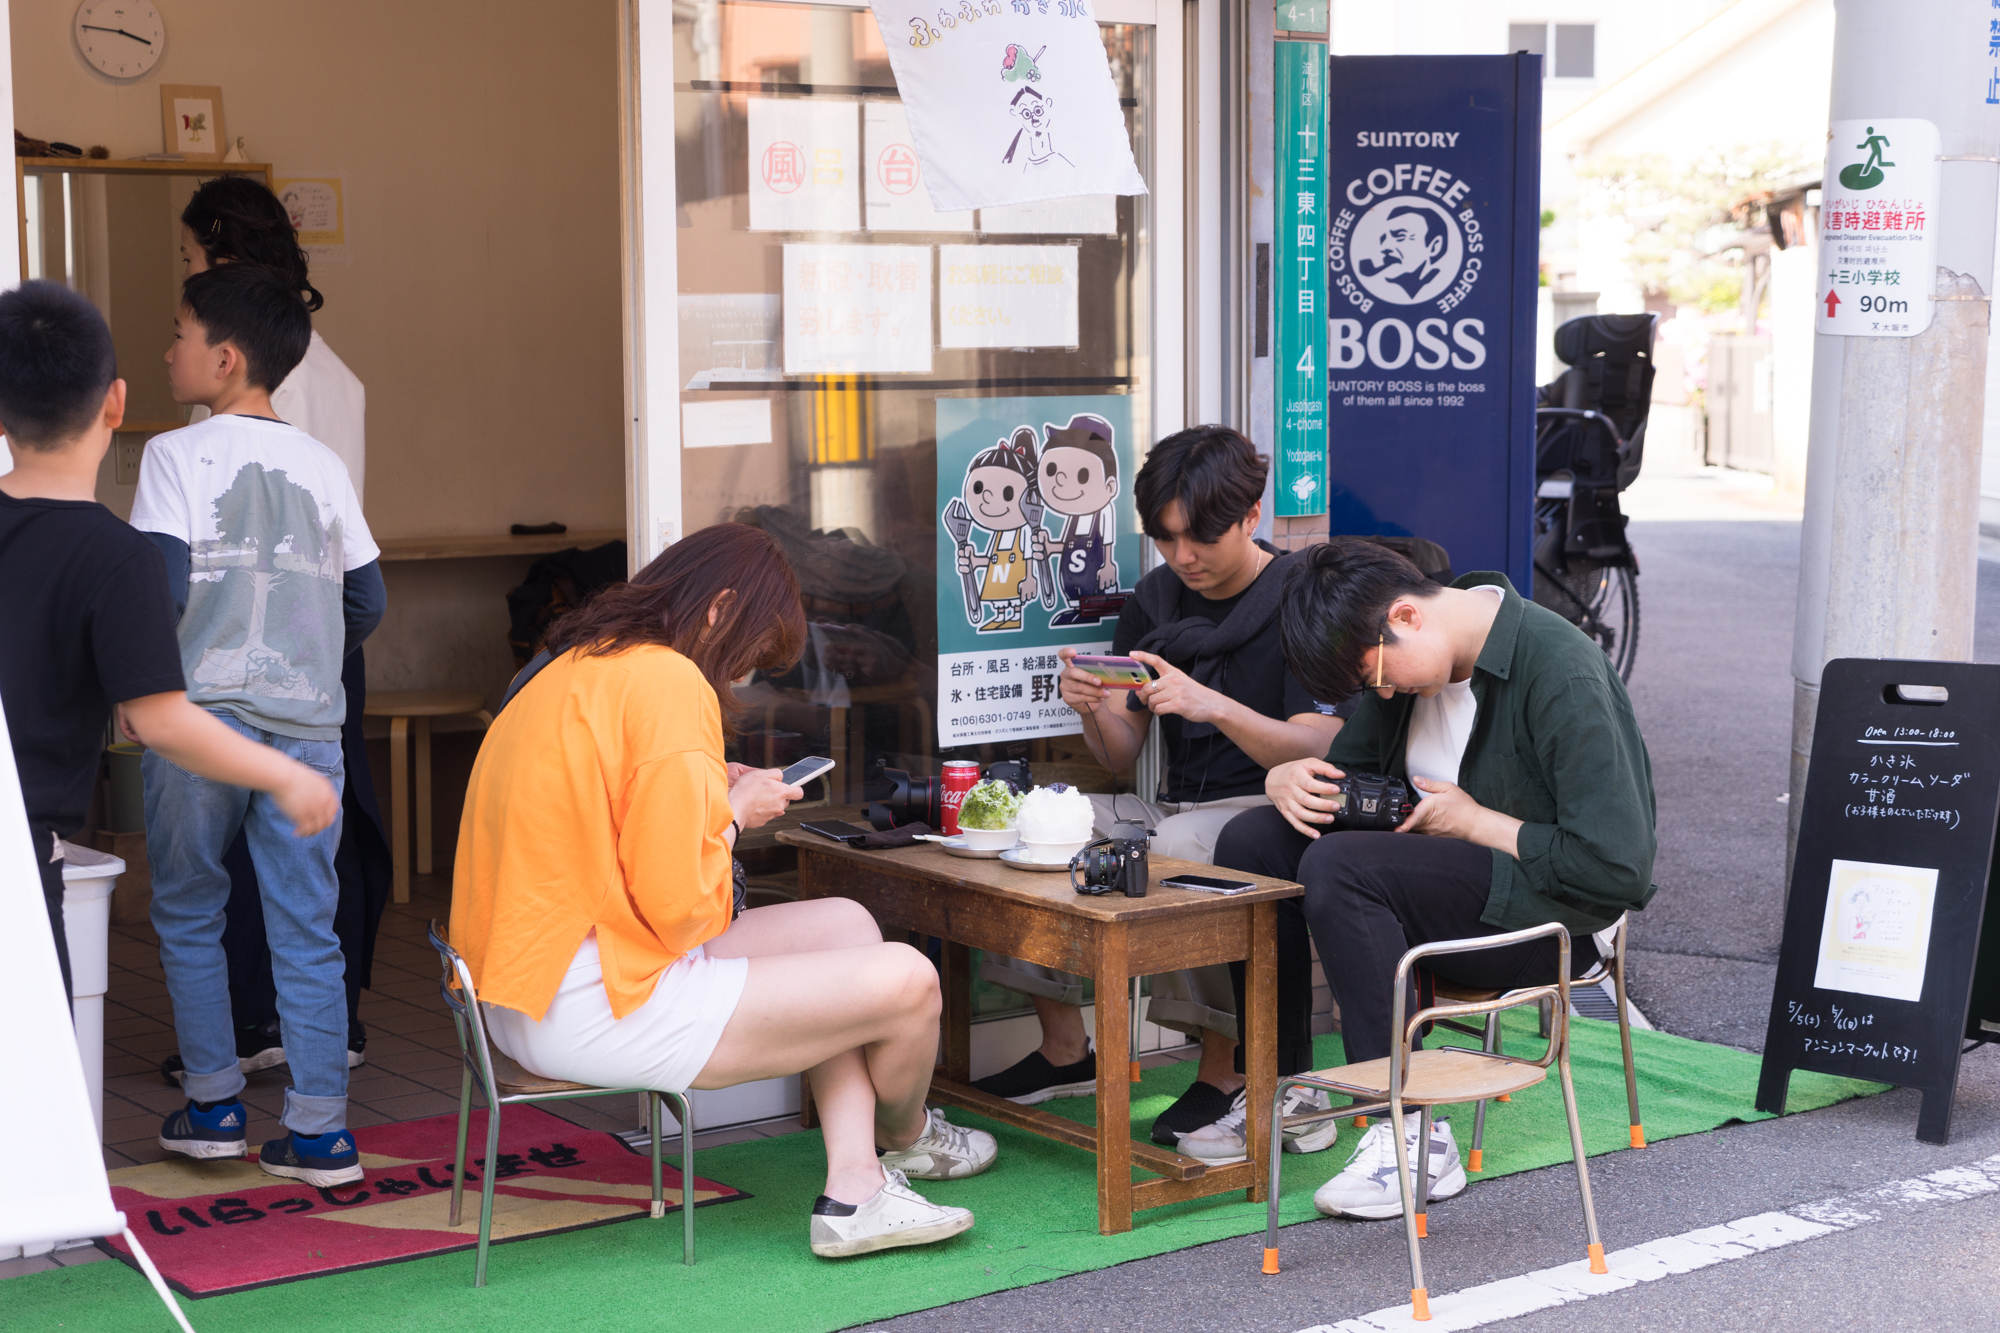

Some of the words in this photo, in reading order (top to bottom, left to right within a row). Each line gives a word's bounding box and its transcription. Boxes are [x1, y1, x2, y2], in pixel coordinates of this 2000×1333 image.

[1287, 5, 1315, 24] 4-1
[1301, 61, 1313, 106] 淀川区
[1356, 131, 1460, 148] SUNTORY
[1346, 163, 1471, 209] COFFEE
[1296, 124, 1316, 315] 十三東四丁目
[1329, 207, 1356, 272] COFFEE
[1458, 208, 1485, 254] BOSS
[947, 264, 1064, 285] お気軽にご相談
[1828, 269, 1901, 286] 十三小学校
[1336, 274, 1375, 314] BOSS
[1436, 257, 1483, 314] COFFEE
[1860, 295, 1909, 314] 90m
[948, 304, 1011, 325] ください。
[1881, 323, 1910, 332] 大阪市
[1329, 317, 1487, 371] BOSS
[1295, 345, 1316, 379] 4
[1387, 380, 1423, 392] BOSS
[1425, 380, 1435, 392] is
[1437, 380, 1456, 392] the
[1458, 381, 1486, 392] boss
[1286, 398, 1323, 415] Jusohigashi
[1343, 395, 1355, 406] of
[1357, 395, 1386, 406] them
[1388, 395, 1401, 407] all
[1403, 395, 1434, 407] since
[1437, 395, 1465, 407] 1992
[1286, 417, 1323, 431] 4-chome
[1286, 447, 1323, 465] Yodogawa-ku
[1068, 549, 1088, 574] S
[991, 562, 1012, 584] N
[950, 654, 1059, 677] 台所・風呂・給湯器
[951, 684, 1023, 703] 氷・住宅設備
[1038, 706, 1082, 718] FAX(06)
[1869, 754, 1917, 770] かき氷
[1864, 788, 1897, 804] 甘酒
[219, 1120, 240, 1128] adidas
[330, 1144, 352, 1154] adidas
